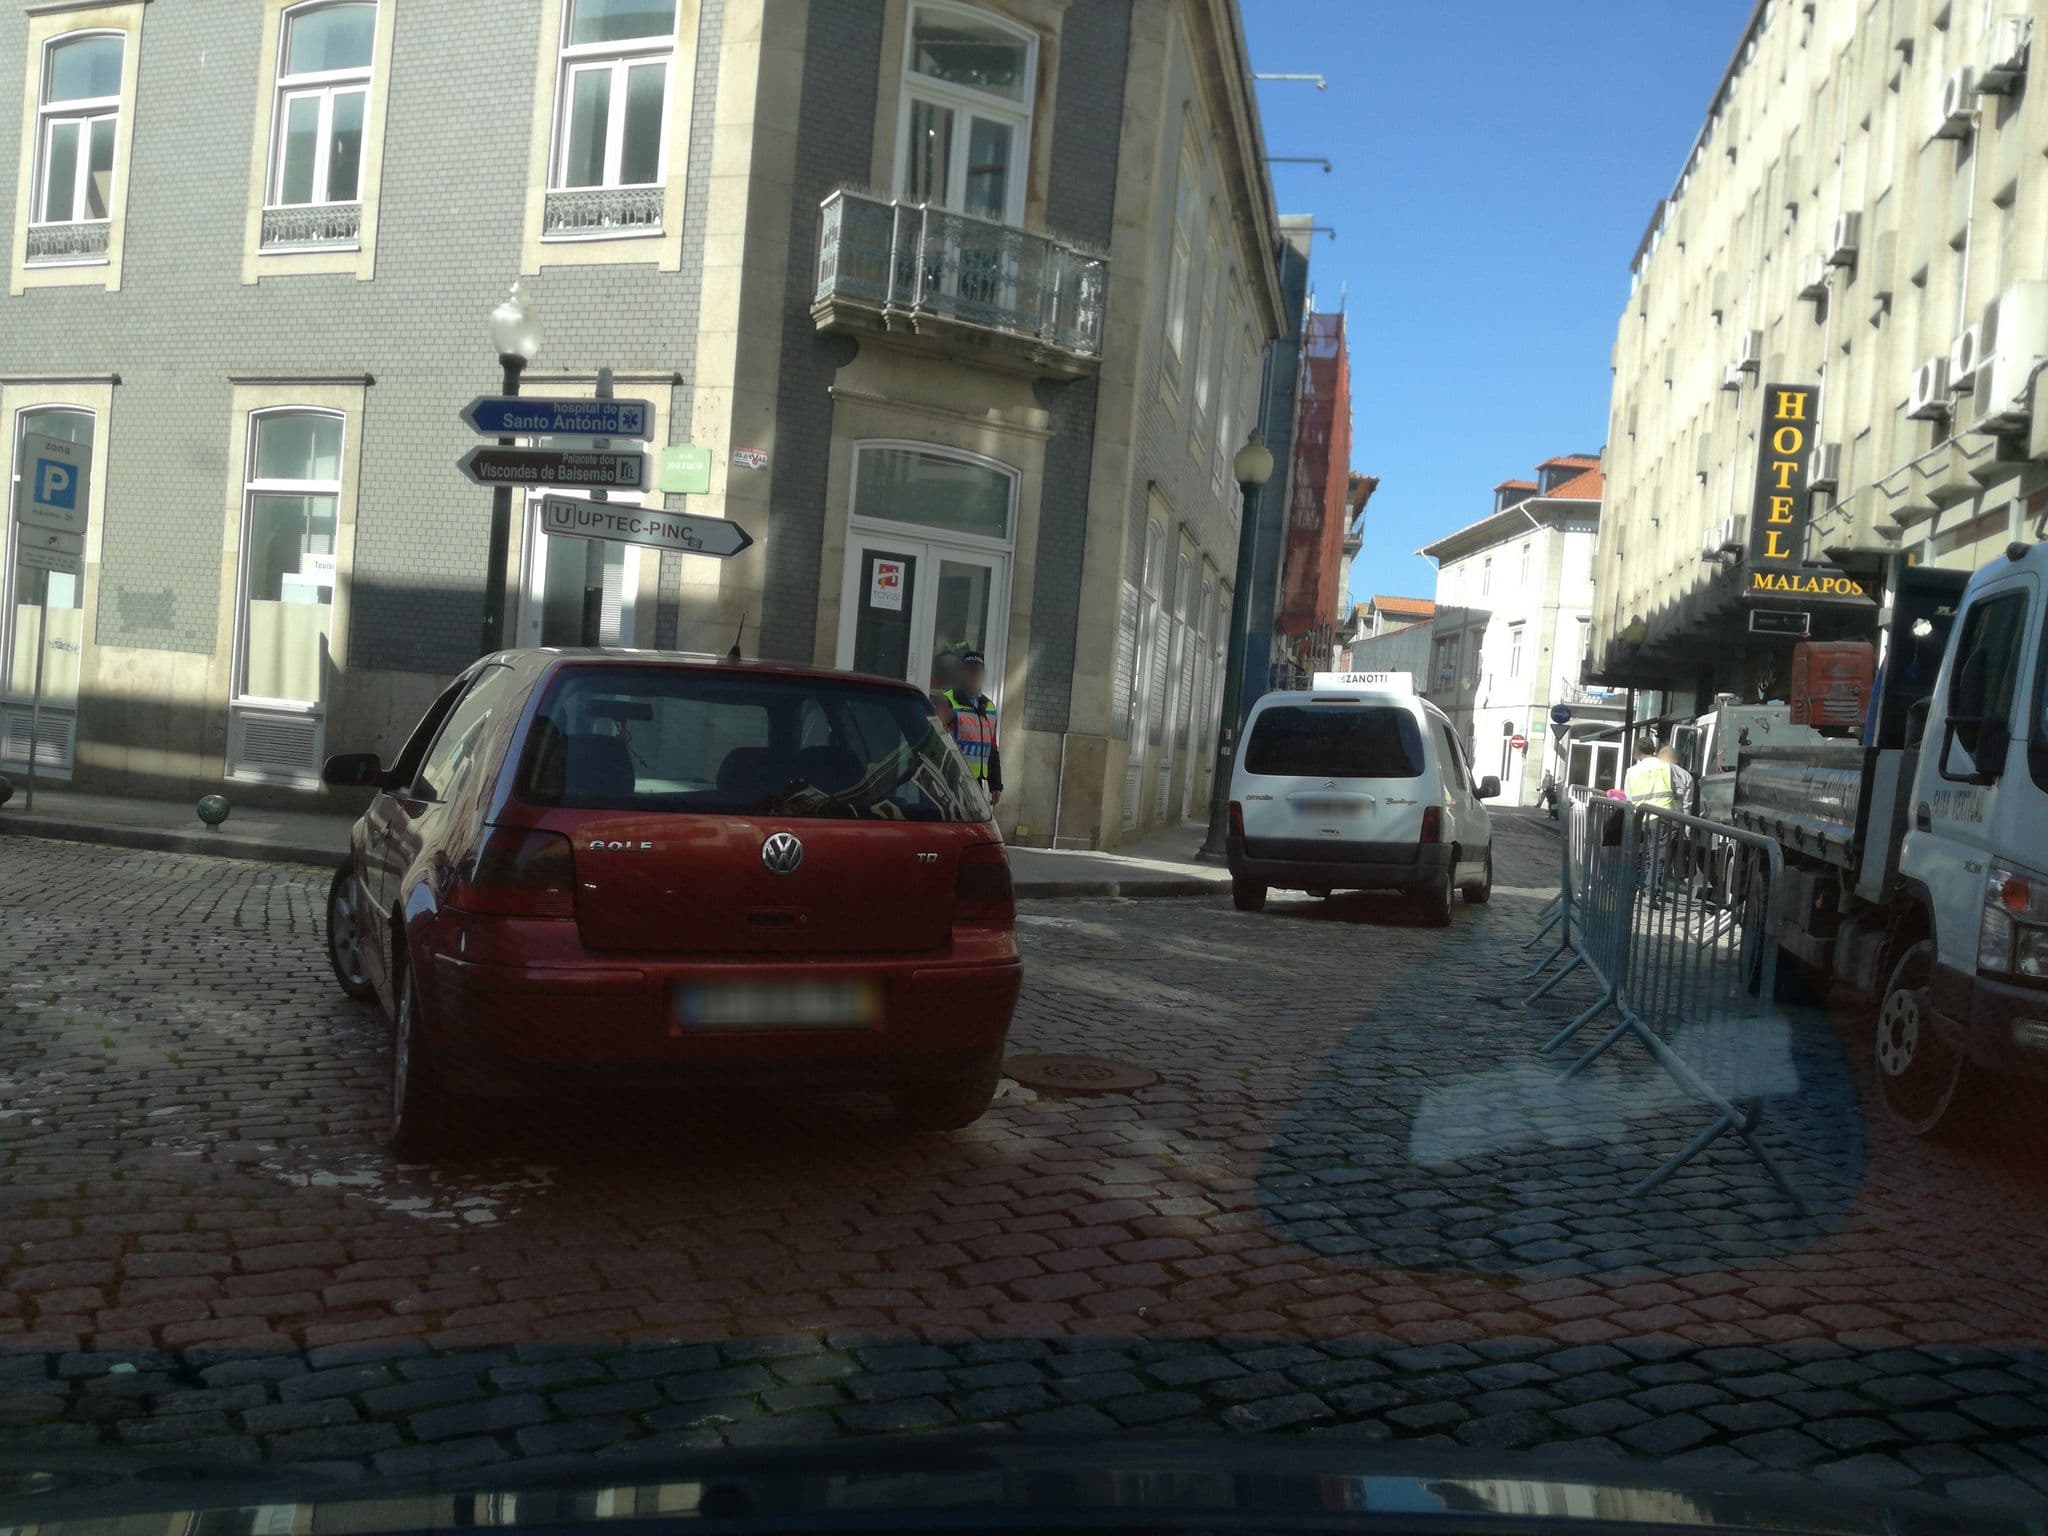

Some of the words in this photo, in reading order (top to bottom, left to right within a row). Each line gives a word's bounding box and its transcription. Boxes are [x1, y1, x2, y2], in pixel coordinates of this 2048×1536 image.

[553, 401, 600, 414] hospital
[604, 404, 617, 413] de
[503, 413, 549, 429] Santo
[553, 414, 617, 431] António
[45, 442, 71, 456] zona
[600, 454, 615, 465] dos
[480, 462, 538, 480] Viscondes
[540, 464, 555, 480] de
[558, 464, 615, 482] Balsemão
[1763, 391, 1808, 559] HOTEL
[42, 464, 70, 502] P
[577, 510, 693, 541] UPTEC-PINC
[1346, 674, 1388, 683] ZANOTTI
[589, 840, 653, 851] GOLF
